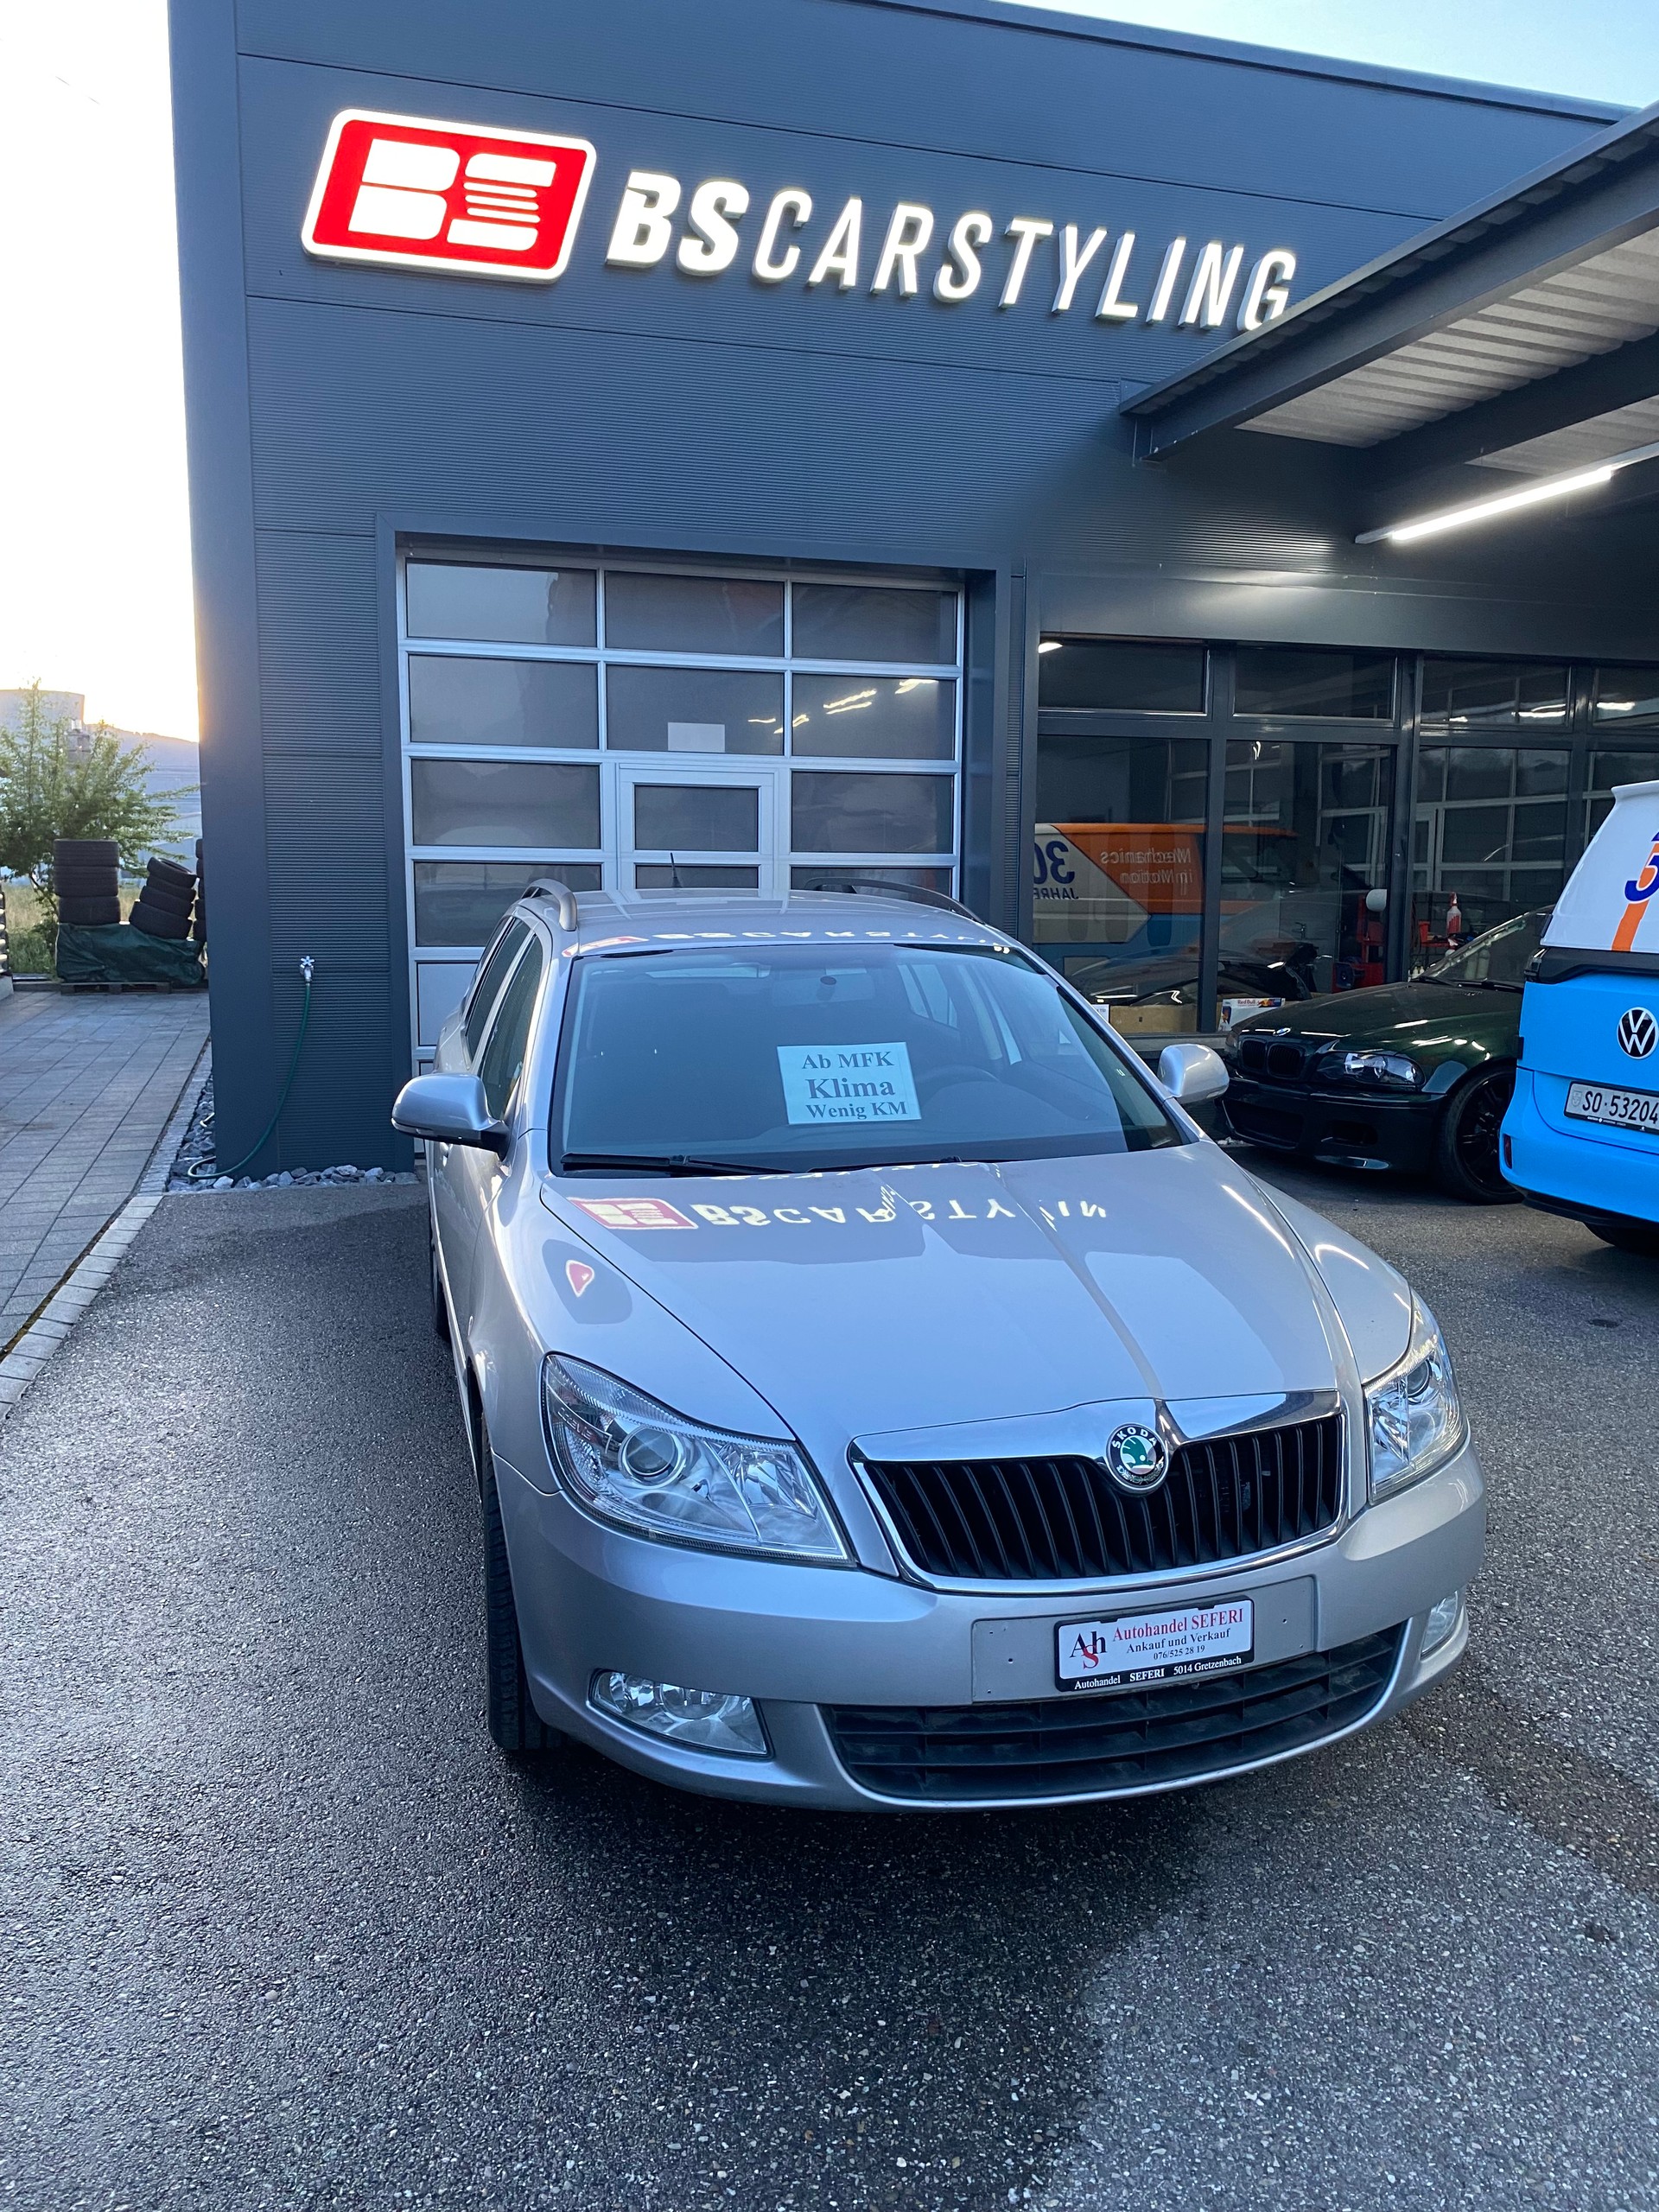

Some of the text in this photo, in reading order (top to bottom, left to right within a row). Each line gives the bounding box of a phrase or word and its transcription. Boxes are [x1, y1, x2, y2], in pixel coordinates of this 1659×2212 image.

[802, 1051, 895, 1070] Ab MFK
[804, 1077, 896, 1099] Klima
[805, 1101, 908, 1120] Wenig KM
[1112, 1608, 1244, 1642] Autohandel SEFERI
[1126, 1628, 1231, 1654] Ankauf und Verkauf
[1196, 1644, 1205, 1654] 19
[1074, 1656, 1243, 1690] Autohandel SEFERI 5014 Gretzenbach
